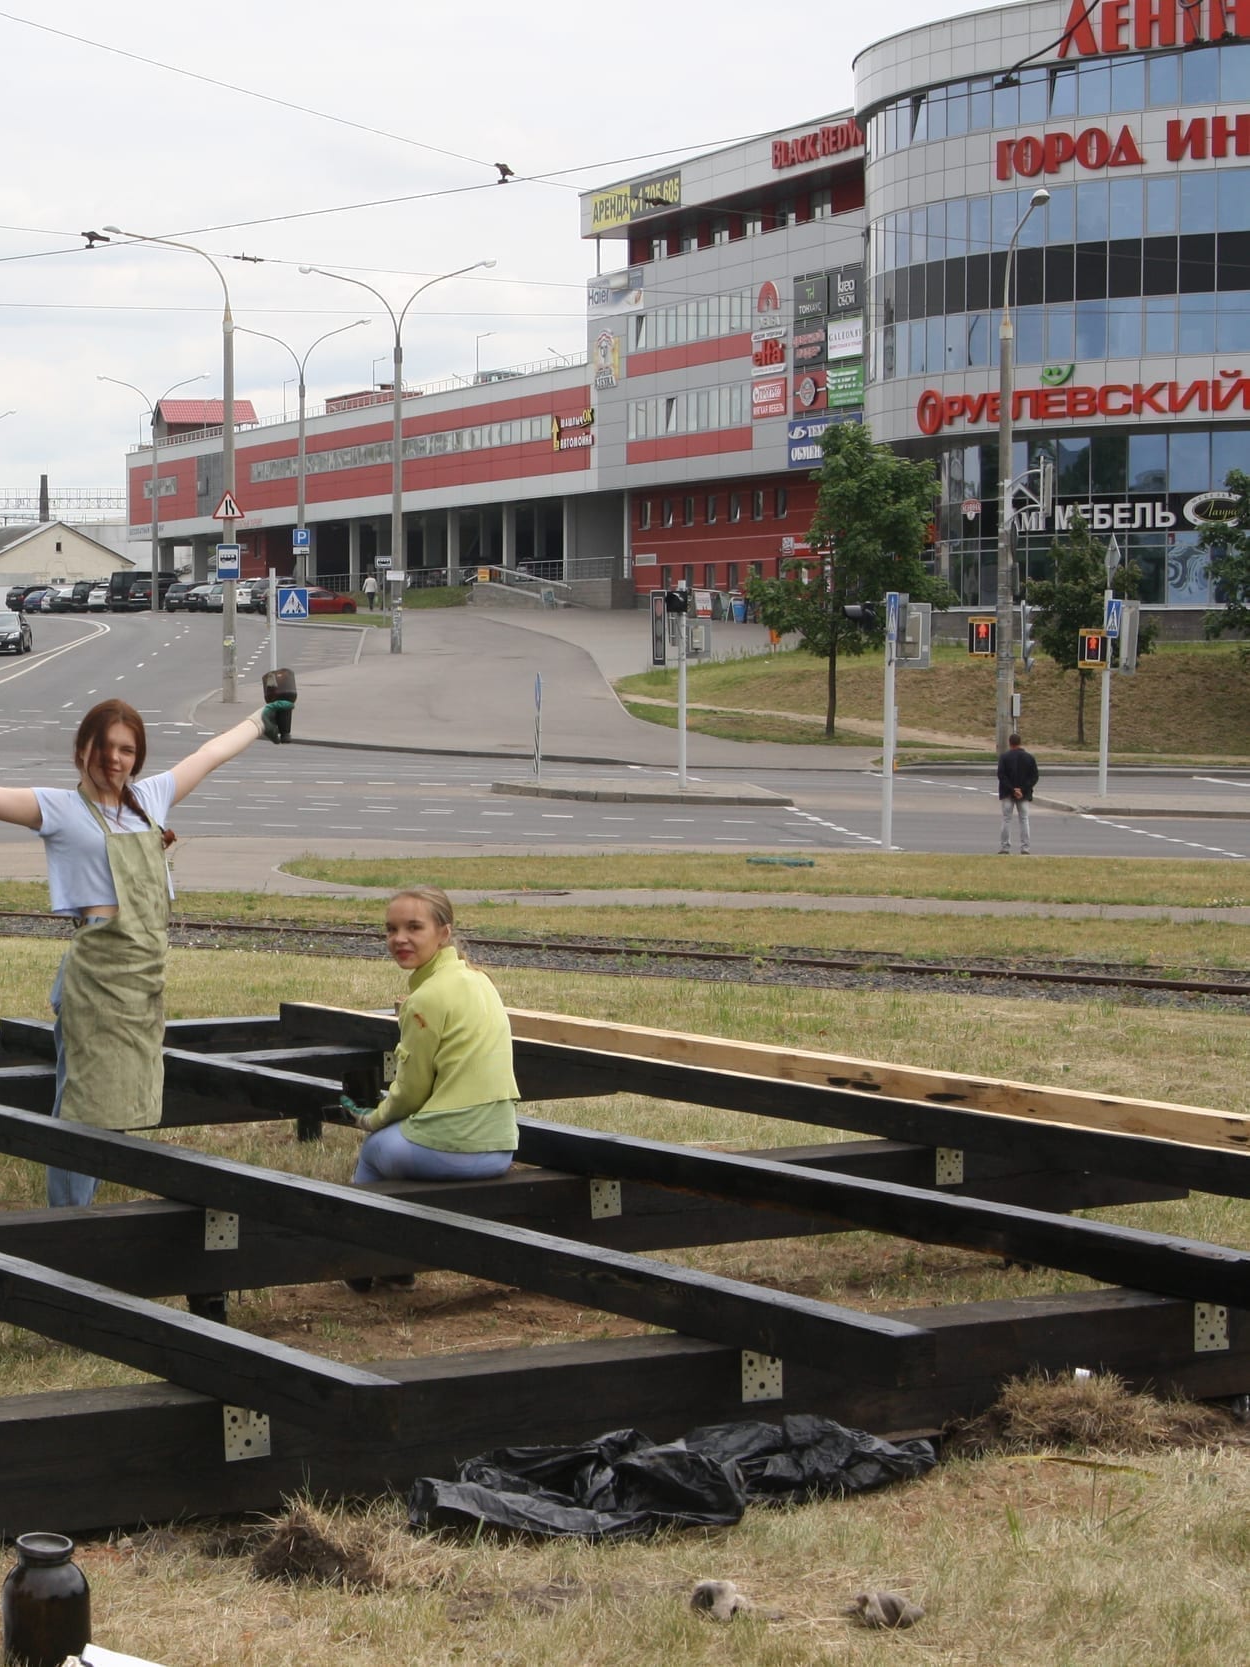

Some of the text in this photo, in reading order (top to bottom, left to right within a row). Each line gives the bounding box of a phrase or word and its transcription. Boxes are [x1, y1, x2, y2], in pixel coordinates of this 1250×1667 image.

[772, 133, 820, 169] BLACK
[996, 114, 1250, 180] ГОРОД ИН
[593, 192, 630, 224] АРЕНДА
[1054, 501, 1177, 531] МЕБЕЛЬ
[297, 531, 307, 544] P
